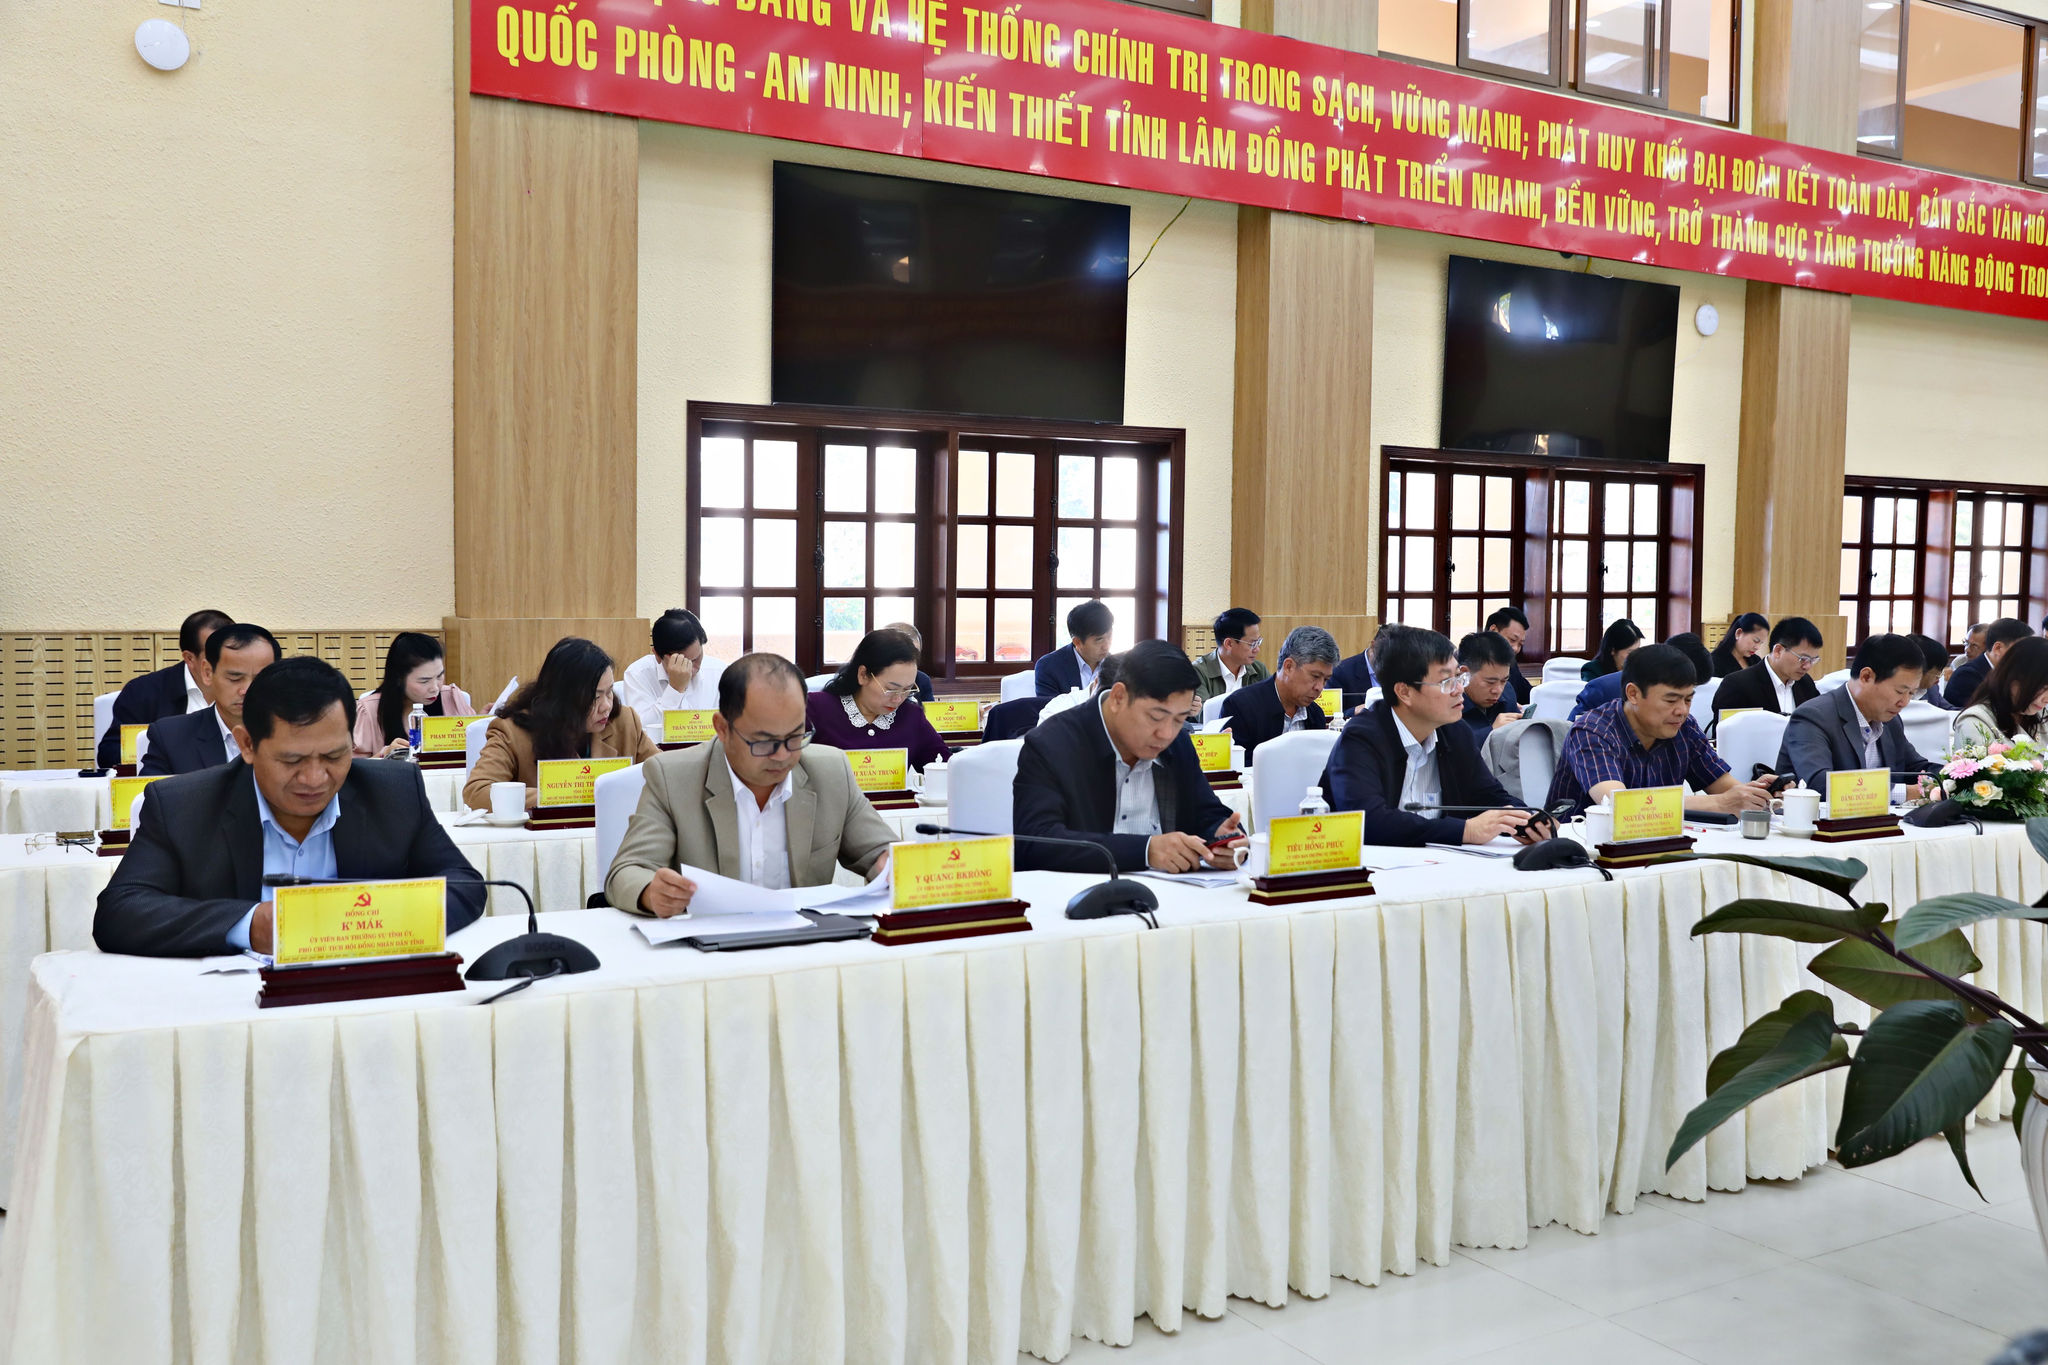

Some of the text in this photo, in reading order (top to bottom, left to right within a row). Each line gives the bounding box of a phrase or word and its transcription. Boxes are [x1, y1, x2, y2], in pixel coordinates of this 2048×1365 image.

[498, 2, 597, 71] QUỐC
[825, 62, 912, 128] NINH;
[924, 73, 996, 133] KIẾN
[1009, 90, 1092, 147] THIẾT
[1105, 100, 1166, 160] TỈNH
[1179, 117, 1236, 170] LÂM
[1247, 126, 1315, 182] ĐỒNG
[1326, 145, 1386, 193] PHÁT
[1397, 153, 1463, 206] TRIỂN
[1472, 172, 1547, 228] NHANH,
[1555, 179, 1595, 228] BỀN
[1605, 189, 1661, 245] VỮNG,
[1668, 199, 1703, 245] TRỞ
[1711, 210, 1768, 255] THÀNH
[1775, 223, 1808, 265] CỰC
[1814, 226, 1856, 268] TĂNG
[1863, 234, 1923, 278] TRƯỞNG
[1930, 246, 1968, 285] NĂNG
[1975, 254, 2014, 295] ĐỘNG
[906, 0, 946, 55] HỆ
[963, 4, 1061, 68] THỐNG
[1073, 28, 1153, 85] CHÍNH
[1167, 47, 1207, 102] TRỊ
[1220, 57, 1300, 111] TRONG
[1313, 76, 1381, 132] SẠCH,
[1391, 84, 1450, 139] VỮNG
[1456, 104, 1528, 160] MẠNH;
[1538, 119, 1590, 164] PHÁT
[1598, 132, 1635, 172] HUY
[1644, 137, 1687, 182] KHỐI
[1692, 151, 1725, 194] ĐẠI
[1732, 156, 1780, 199] ĐOÀN
[1787, 163, 1820, 206] KẾT
[1827, 174, 1871, 216] TOÀN
[1877, 181, 1913, 229] DÂN,
[1919, 188, 1952, 229] BẢN
[1955, 190, 1988, 235] SẮC
[1993, 204, 2021, 241] VĂN
[2027, 209, 2048, 247] HÓ
[356, 918, 384, 930] MÁK
[915, 875, 920, 884] Y
[923, 872, 954, 884] QUANG
